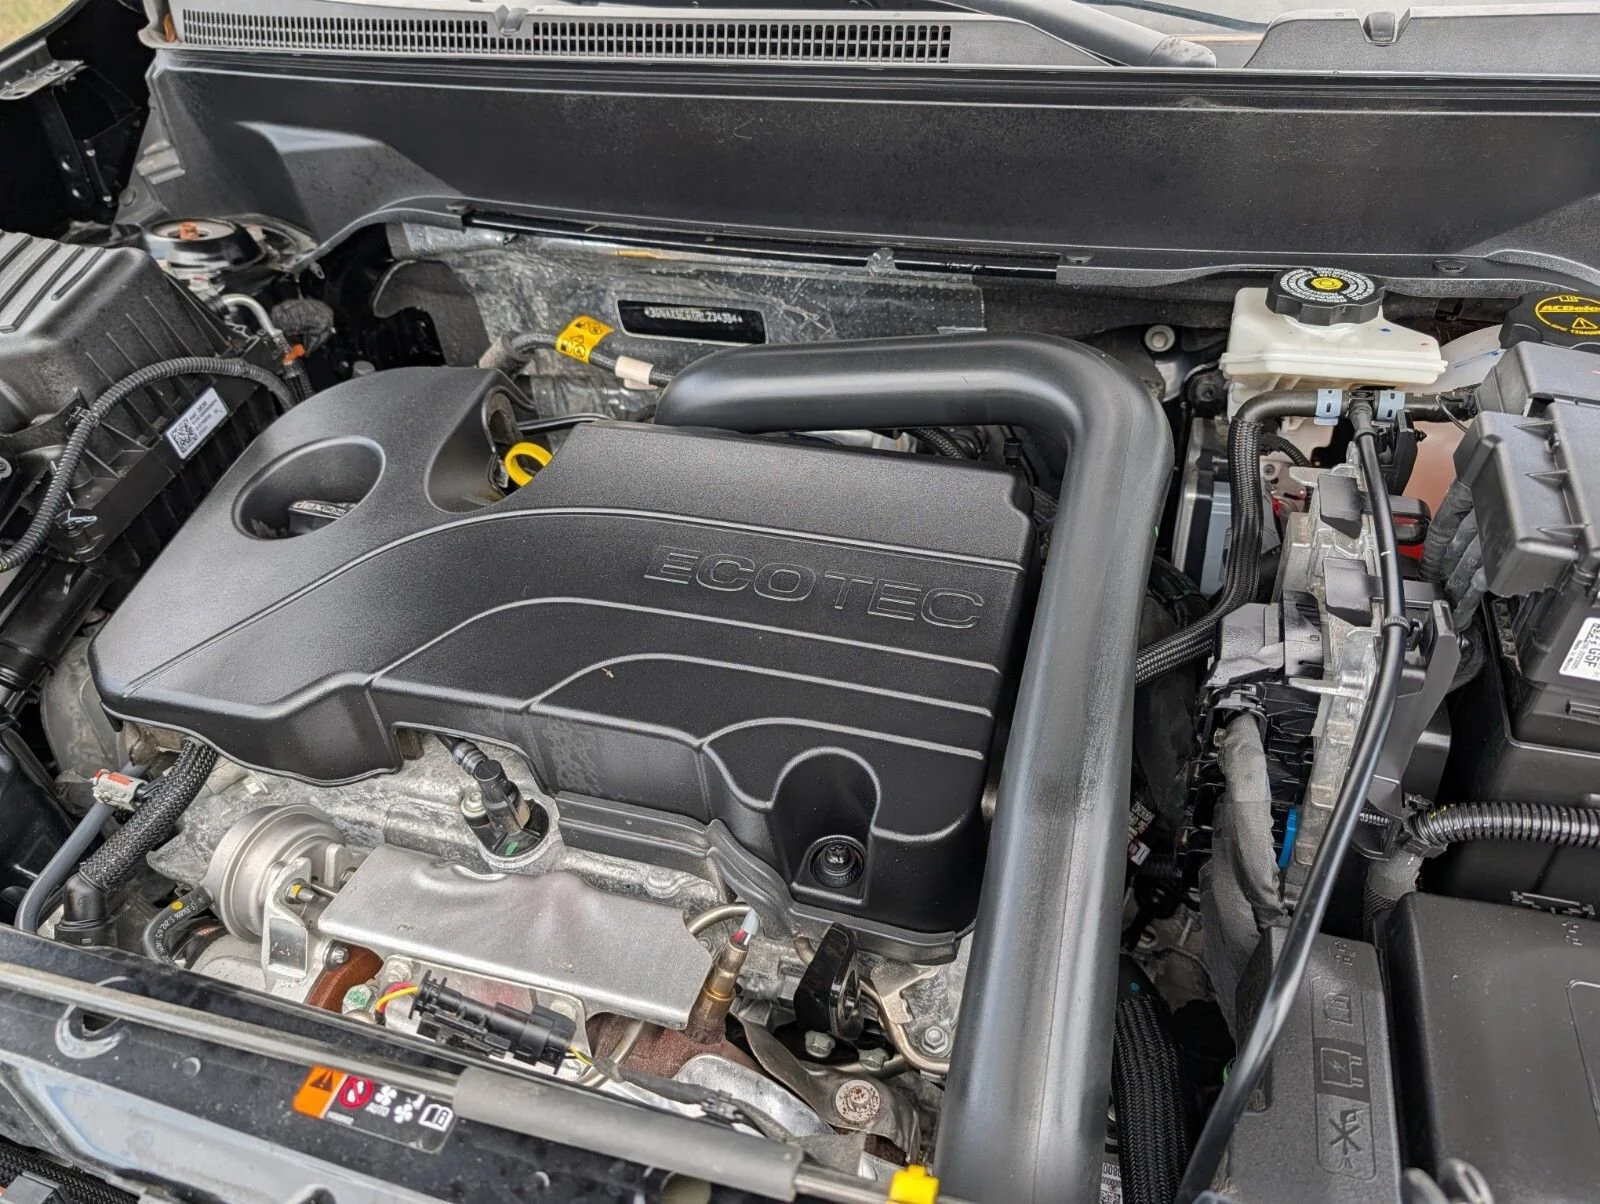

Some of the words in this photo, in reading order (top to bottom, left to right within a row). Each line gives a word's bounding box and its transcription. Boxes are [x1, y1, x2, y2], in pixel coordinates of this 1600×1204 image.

[643, 546, 984, 629] ECOTEC
[1583, 647, 1600, 668] G5F
[365, 1101, 390, 1118] AUTO
